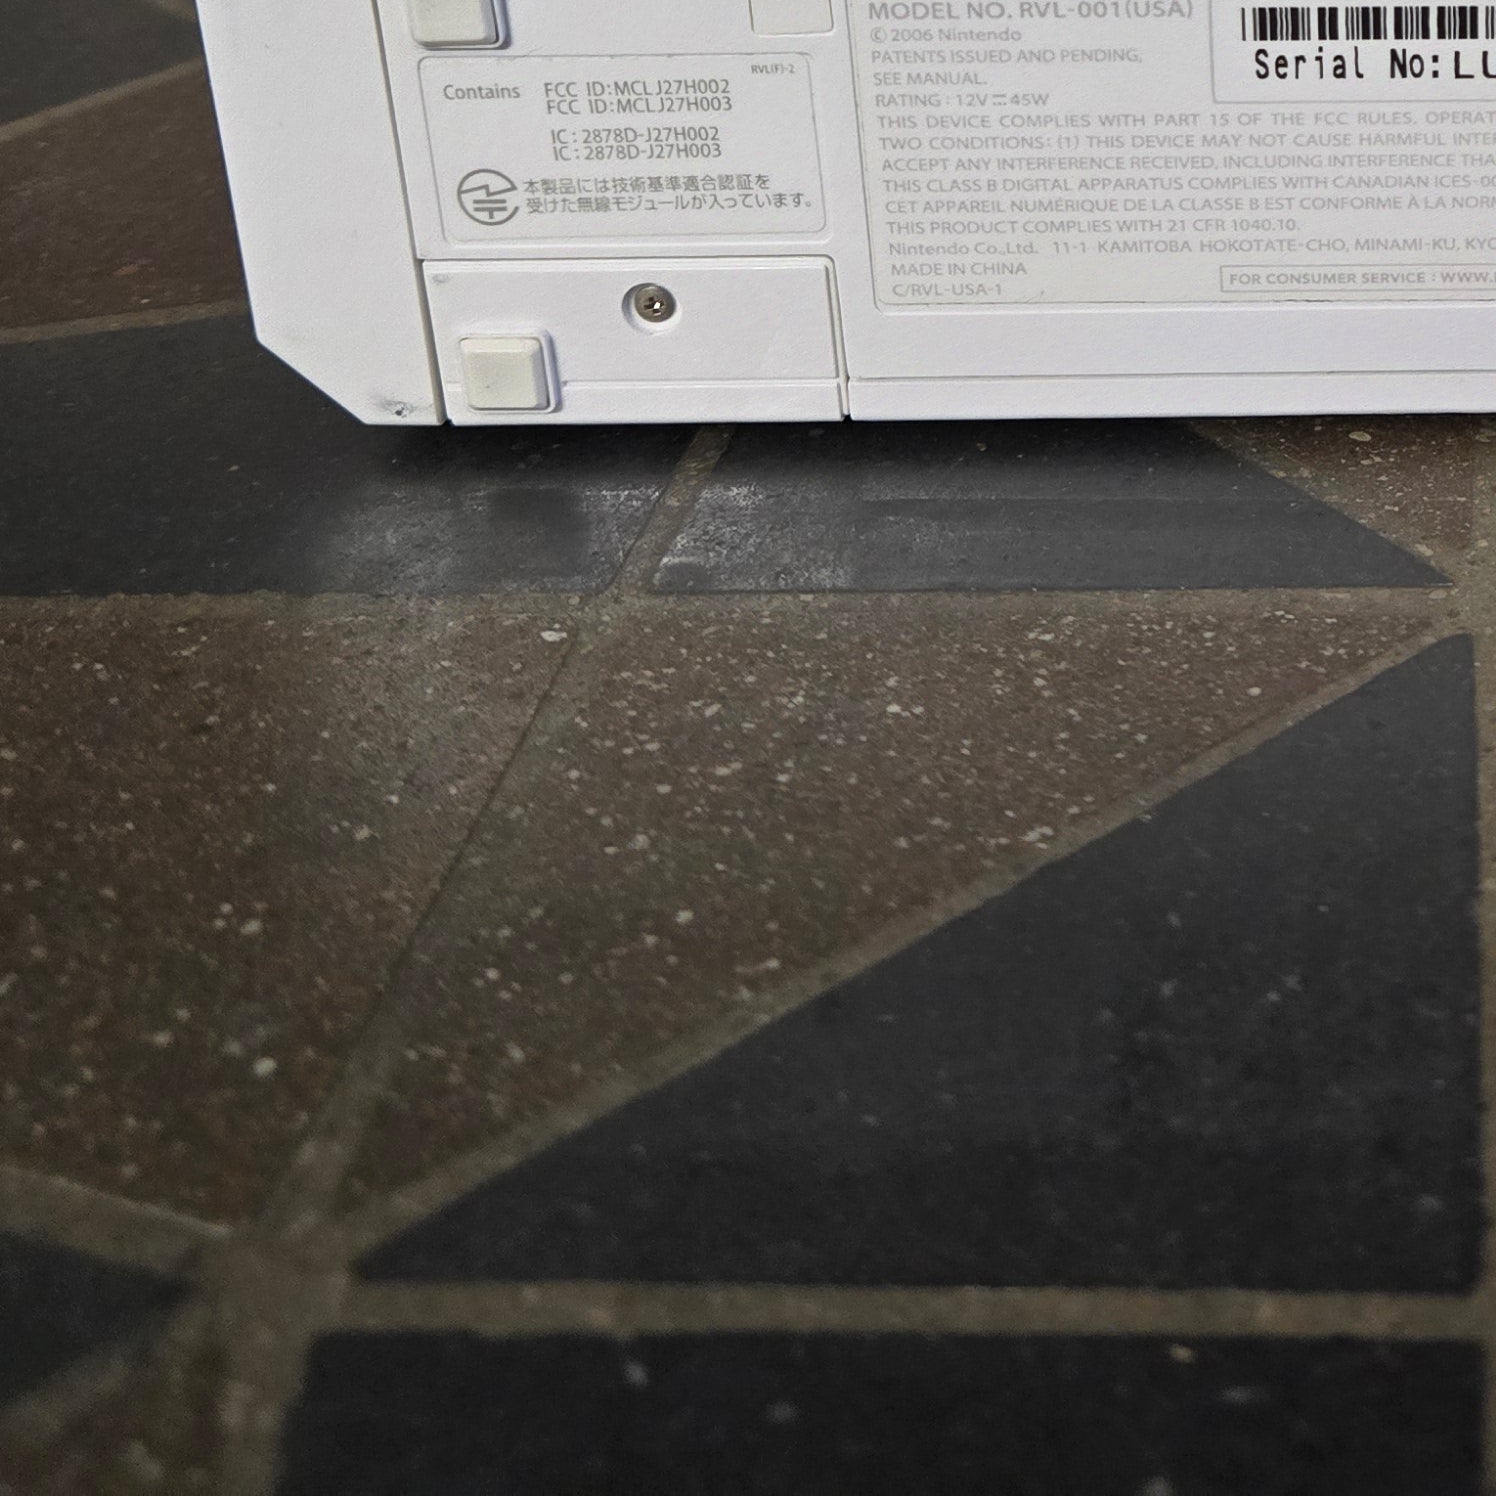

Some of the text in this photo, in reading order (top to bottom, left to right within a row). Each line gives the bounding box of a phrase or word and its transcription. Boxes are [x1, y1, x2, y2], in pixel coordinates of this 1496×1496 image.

[868, 0, 960, 20] MODEL
[1018, 0, 1194, 20] RVL-001(USA)
[890, 28, 934, 42] 2006
[937, 27, 1023, 43] Nintendo
[871, 49, 947, 64] PATENTS
[950, 49, 1013, 64] ISSUED
[1015, 48, 1057, 63] AND
[1254, 46, 1364, 79] Serial
[872, 71, 902, 86] SEE
[442, 82, 521, 100] Contains
[543, 81, 578, 101] FCC
[546, 98, 581, 115] FCC
[874, 93, 942, 108] RATING
[876, 114, 918, 129] THIS
[925, 114, 992, 129] DEVICE
[998, 113, 1092, 129] COMPLIES
[1097, 114, 1147, 128] WITH
[1153, 112, 1201, 126] PART
[1210, 113, 1230, 127] 15
[1236, 113, 1262, 127] OF
[1270, 111, 1305, 126] THE
[1313, 111, 1349, 126] FCC
[581, 126, 720, 146] 2878D-J27H002
[877, 136, 923, 150] TWO
[928, 135, 1051, 150] CONDITIONS:
[1056, 135, 1080, 150] (1)
[1085, 135, 1126, 149] THIS
[1130, 134, 1195, 149] DEVICE
[1201, 133, 1243, 148] MAY
[1248, 133, 1287, 147] NOT
[1292, 133, 1352, 148] CAUSE
[1358, 132, 1447, 146] HARMFUL
[583, 142, 723, 161] 2878D-J27H003
[881, 157, 950, 171] ACCEPT
[954, 158, 992, 172] ANY
[996, 156, 1125, 171] INTERFERENCE
[1222, 154, 1323, 169] INCLUDING
[1327, 153, 1455, 168] INTERFERENCE
[882, 178, 922, 193] THIS
[925, 178, 983, 193] CLASS
[986, 179, 998, 193] B
[1002, 177, 1072, 192] DIGITAL
[1077, 176, 1184, 191] APPARATUS
[1187, 176, 1278, 190] COMPLIES
[1281, 175, 1328, 190] WITH
[1331, 175, 1430, 189] CANADIAN
[884, 200, 918, 214] CET
[922, 199, 1005, 214] APPAREIL
[1009, 198, 1119, 214] NUMÉRIQUE
[1122, 199, 1147, 212] DE
[1151, 198, 1175, 212] LA
[1178, 197, 1244, 211] CLASSE
[1248, 198, 1260, 211] B
[1264, 197, 1295, 211] EST
[1298, 196, 1403, 211] CONFORME
[1407, 194, 1421, 210] À
[1423, 195, 1447, 210] LA
[885, 220, 926, 234] THIS
[929, 220, 1019, 235] PRODUCT
[1021, 219, 1113, 234] COMPLIES
[1115, 220, 1163, 233] WITH
[1167, 218, 1186, 232] 21
[1192, 218, 1226, 232] CFR
[888, 241, 970, 256] Nintendo
[1052, 241, 1087, 255] 11-1
[1097, 239, 1193, 254] KAMITOBA
[890, 262, 1028, 276] MADE IN CHINA
[1229, 272, 1262, 285] FOR
[1265, 272, 1357, 284] CONSUMER
[1361, 272, 1426, 284] SERVICE
[891, 283, 1002, 297] C/RVL-USA-1
